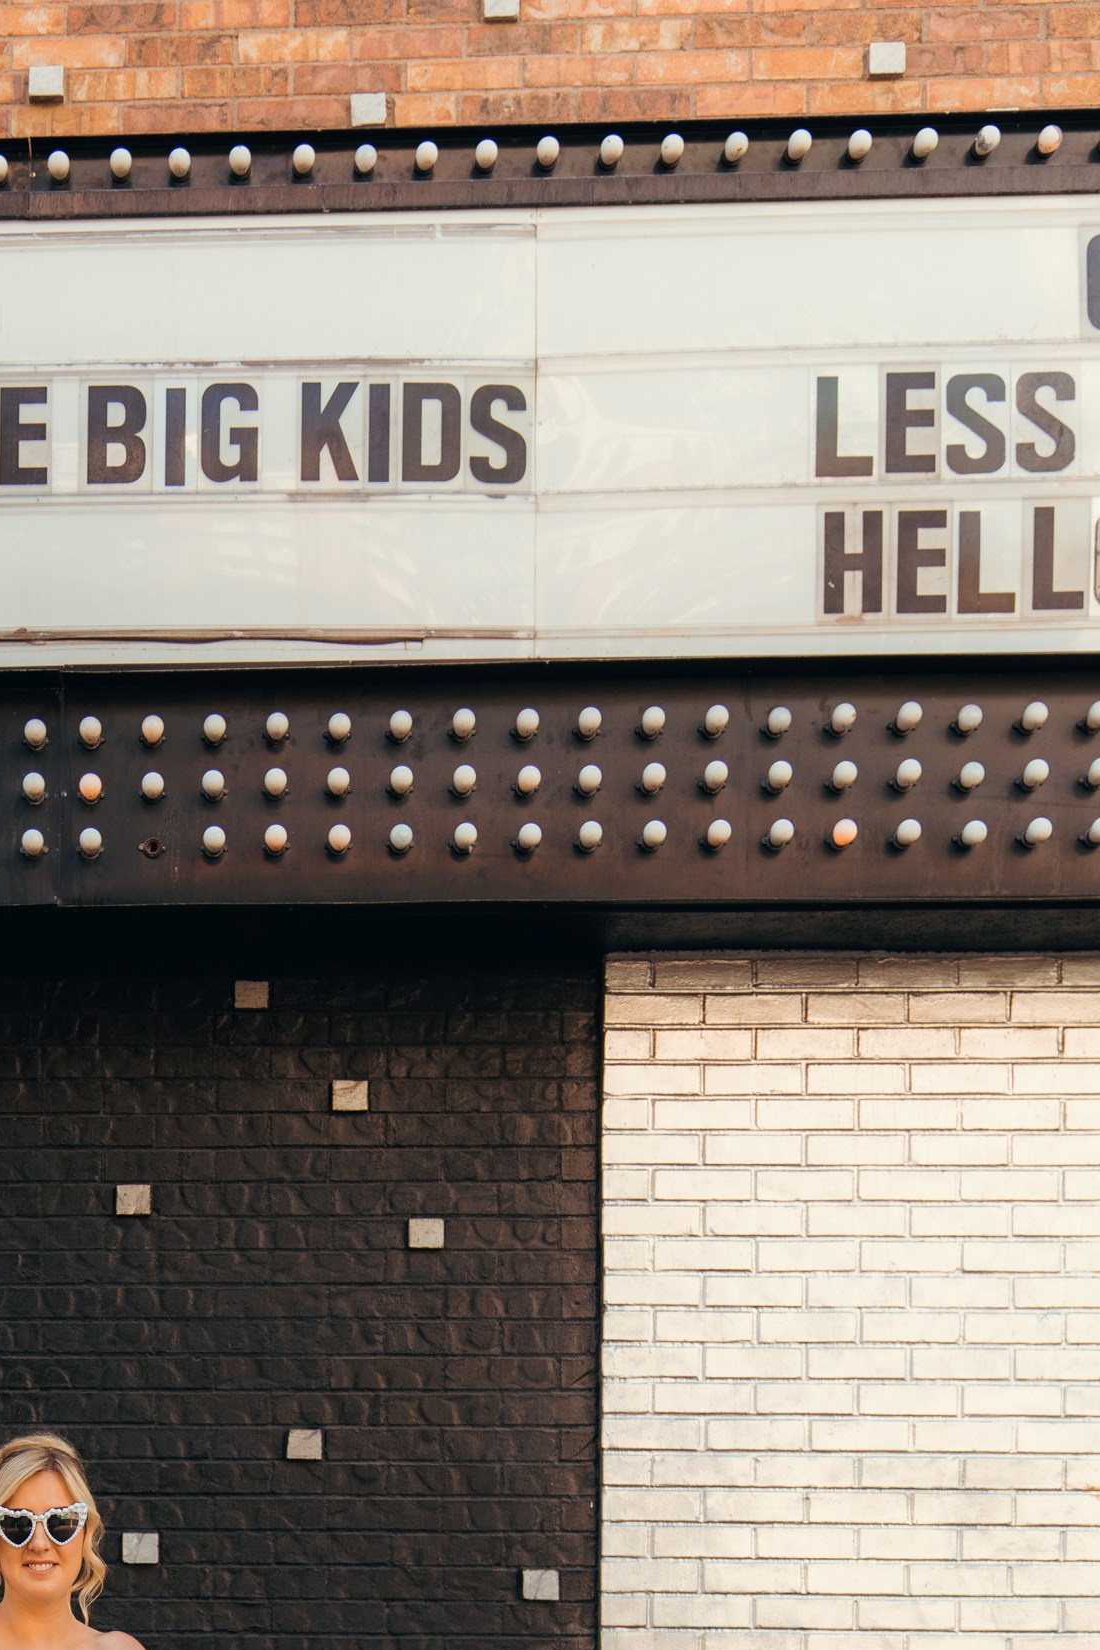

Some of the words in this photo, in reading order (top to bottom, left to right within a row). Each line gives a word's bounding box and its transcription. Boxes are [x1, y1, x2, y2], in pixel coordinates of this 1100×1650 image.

[87, 381, 259, 488] BIG
[301, 380, 527, 485] KIDS
[815, 371, 1076, 478] LESS
[823, 506, 1100, 614] HELL
